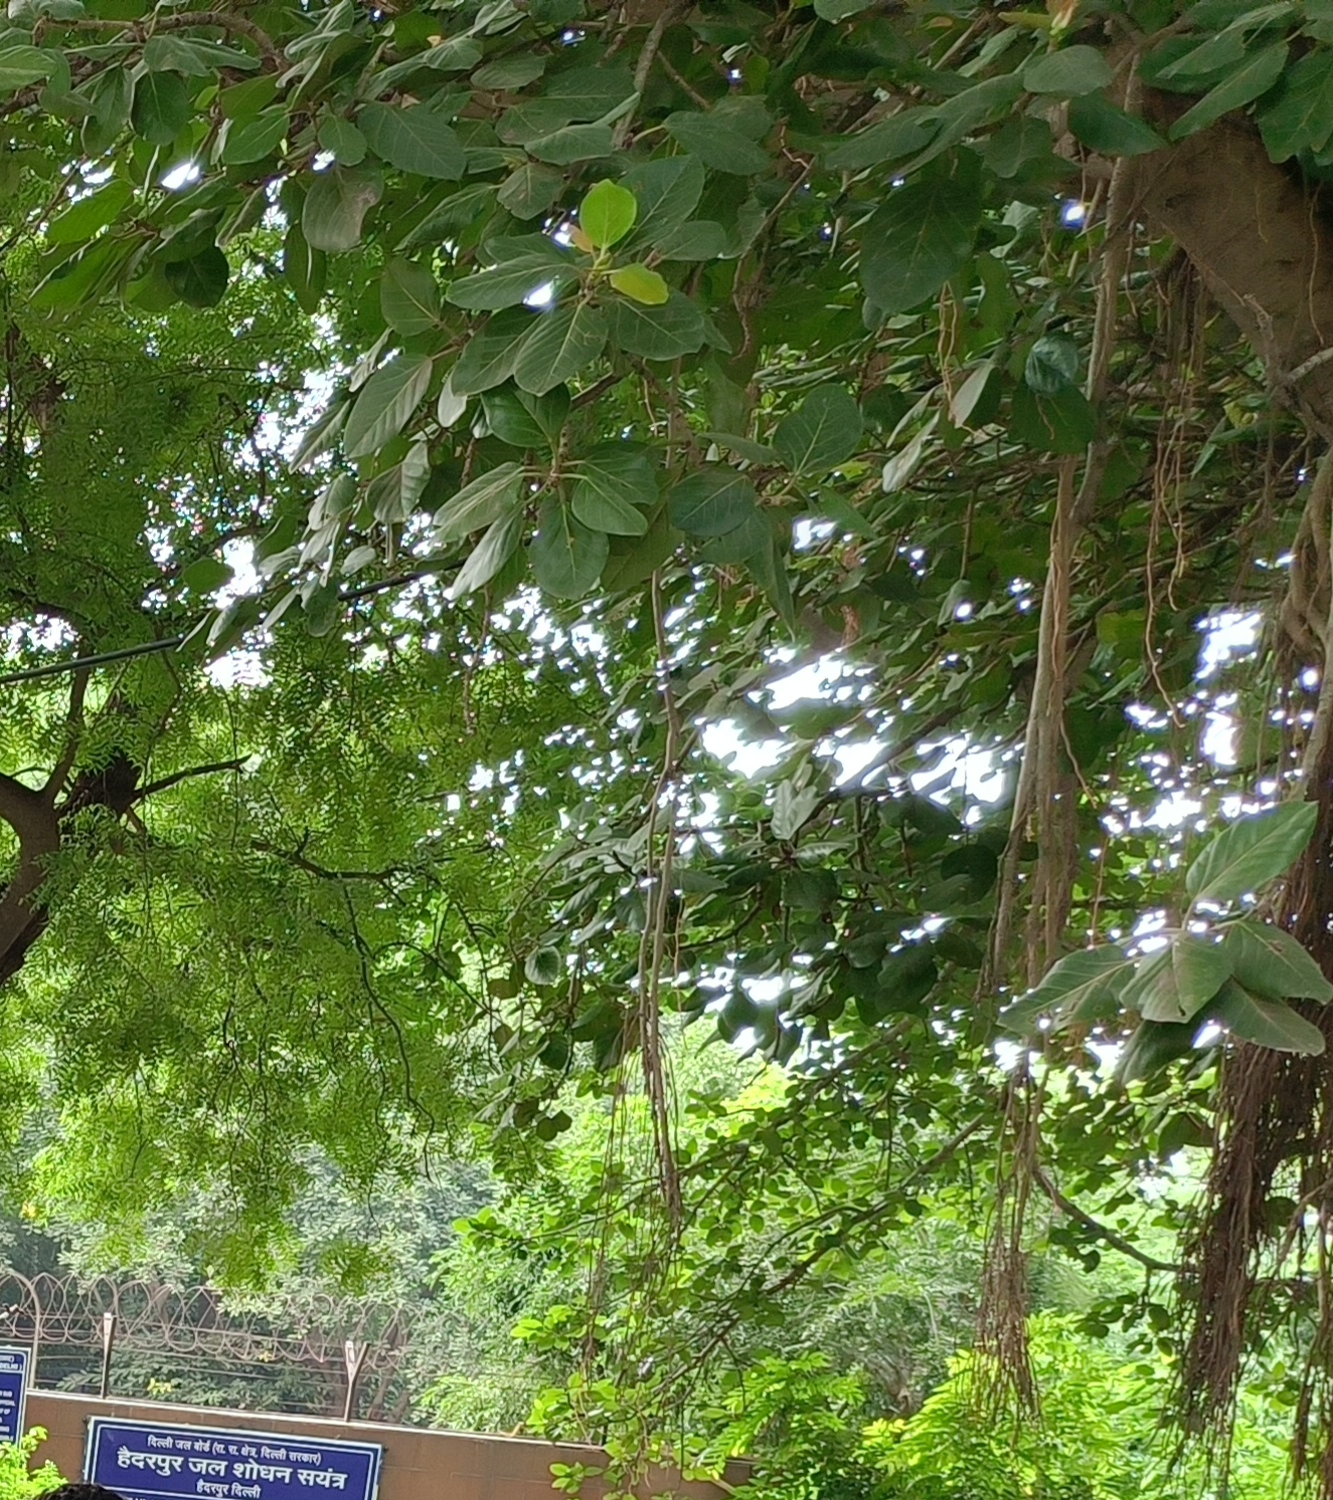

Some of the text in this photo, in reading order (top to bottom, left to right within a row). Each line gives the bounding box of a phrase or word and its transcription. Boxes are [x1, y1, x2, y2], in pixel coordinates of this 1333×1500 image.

[148, 1434, 173, 1449] दिल्ली
[175, 1440, 191, 1451] जल
[194, 1439, 211, 1452] बोर्ड
[260, 1445, 287, 1460] दिल्ली
[289, 1451, 322, 1466] सरकार)
[117, 1445, 348, 1490] हैदरपुर जल शोधन सयंत्र
[196, 1478, 261, 1499] हैदरपुर दिल्ली
